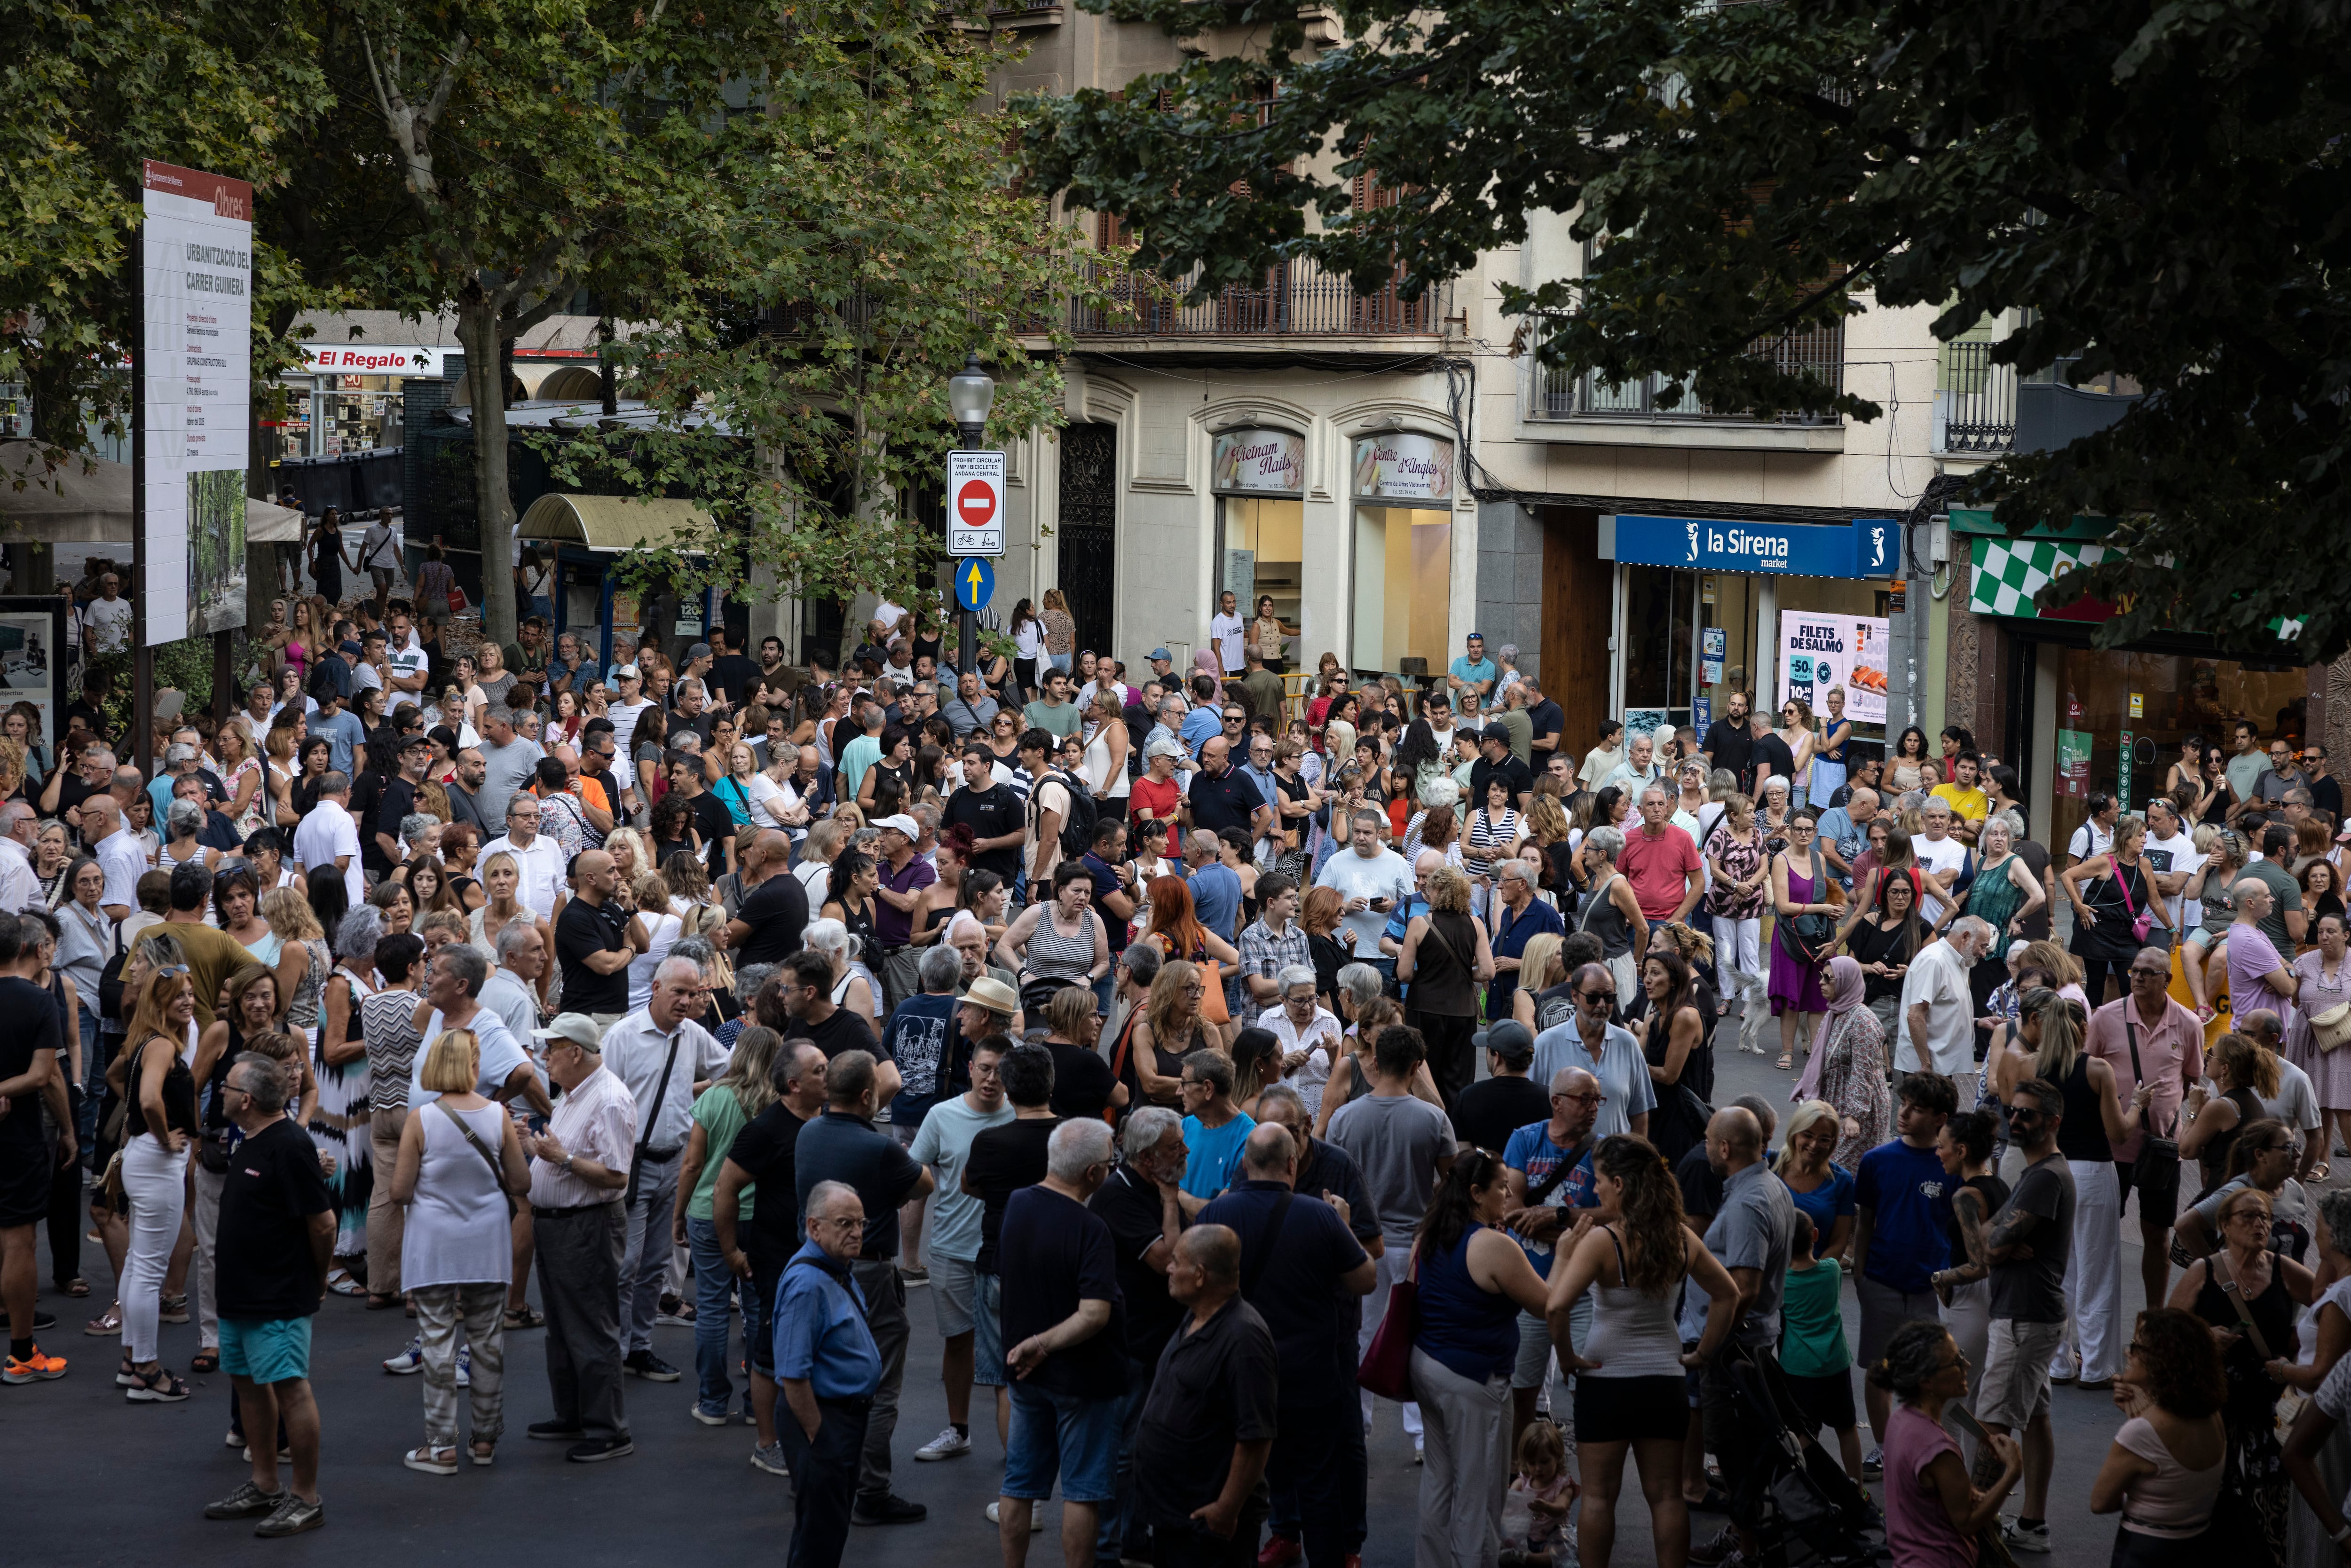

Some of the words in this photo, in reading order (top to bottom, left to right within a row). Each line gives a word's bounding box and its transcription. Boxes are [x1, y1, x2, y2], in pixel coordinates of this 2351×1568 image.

[215, 185, 243, 220] Obres
[187, 243, 236, 268] URBANITZACIÓ
[237, 251, 249, 269] DEL
[187, 271, 213, 292] CARRER
[215, 275, 244, 296] GUIMERÀ
[318, 352, 337, 365] El
[342, 352, 405, 369] Regalo
[1231, 442, 1278, 463] Vietnam
[1373, 444, 1398, 461] Centre
[1260, 453, 1292, 475] Nails
[1398, 457, 1439, 480] d'Ungles
[1708, 528, 1724, 552] la
[1728, 529, 1788, 557] Sirena
[1760, 559, 1787, 568] market
[1800, 625, 1834, 639] FILETS
[1791, 637, 1805, 649] DE
[1806, 638, 1843, 653] SALMÓ
[890, 673, 908, 681] BONNE
[2071, 753, 2089, 762] Moliné
